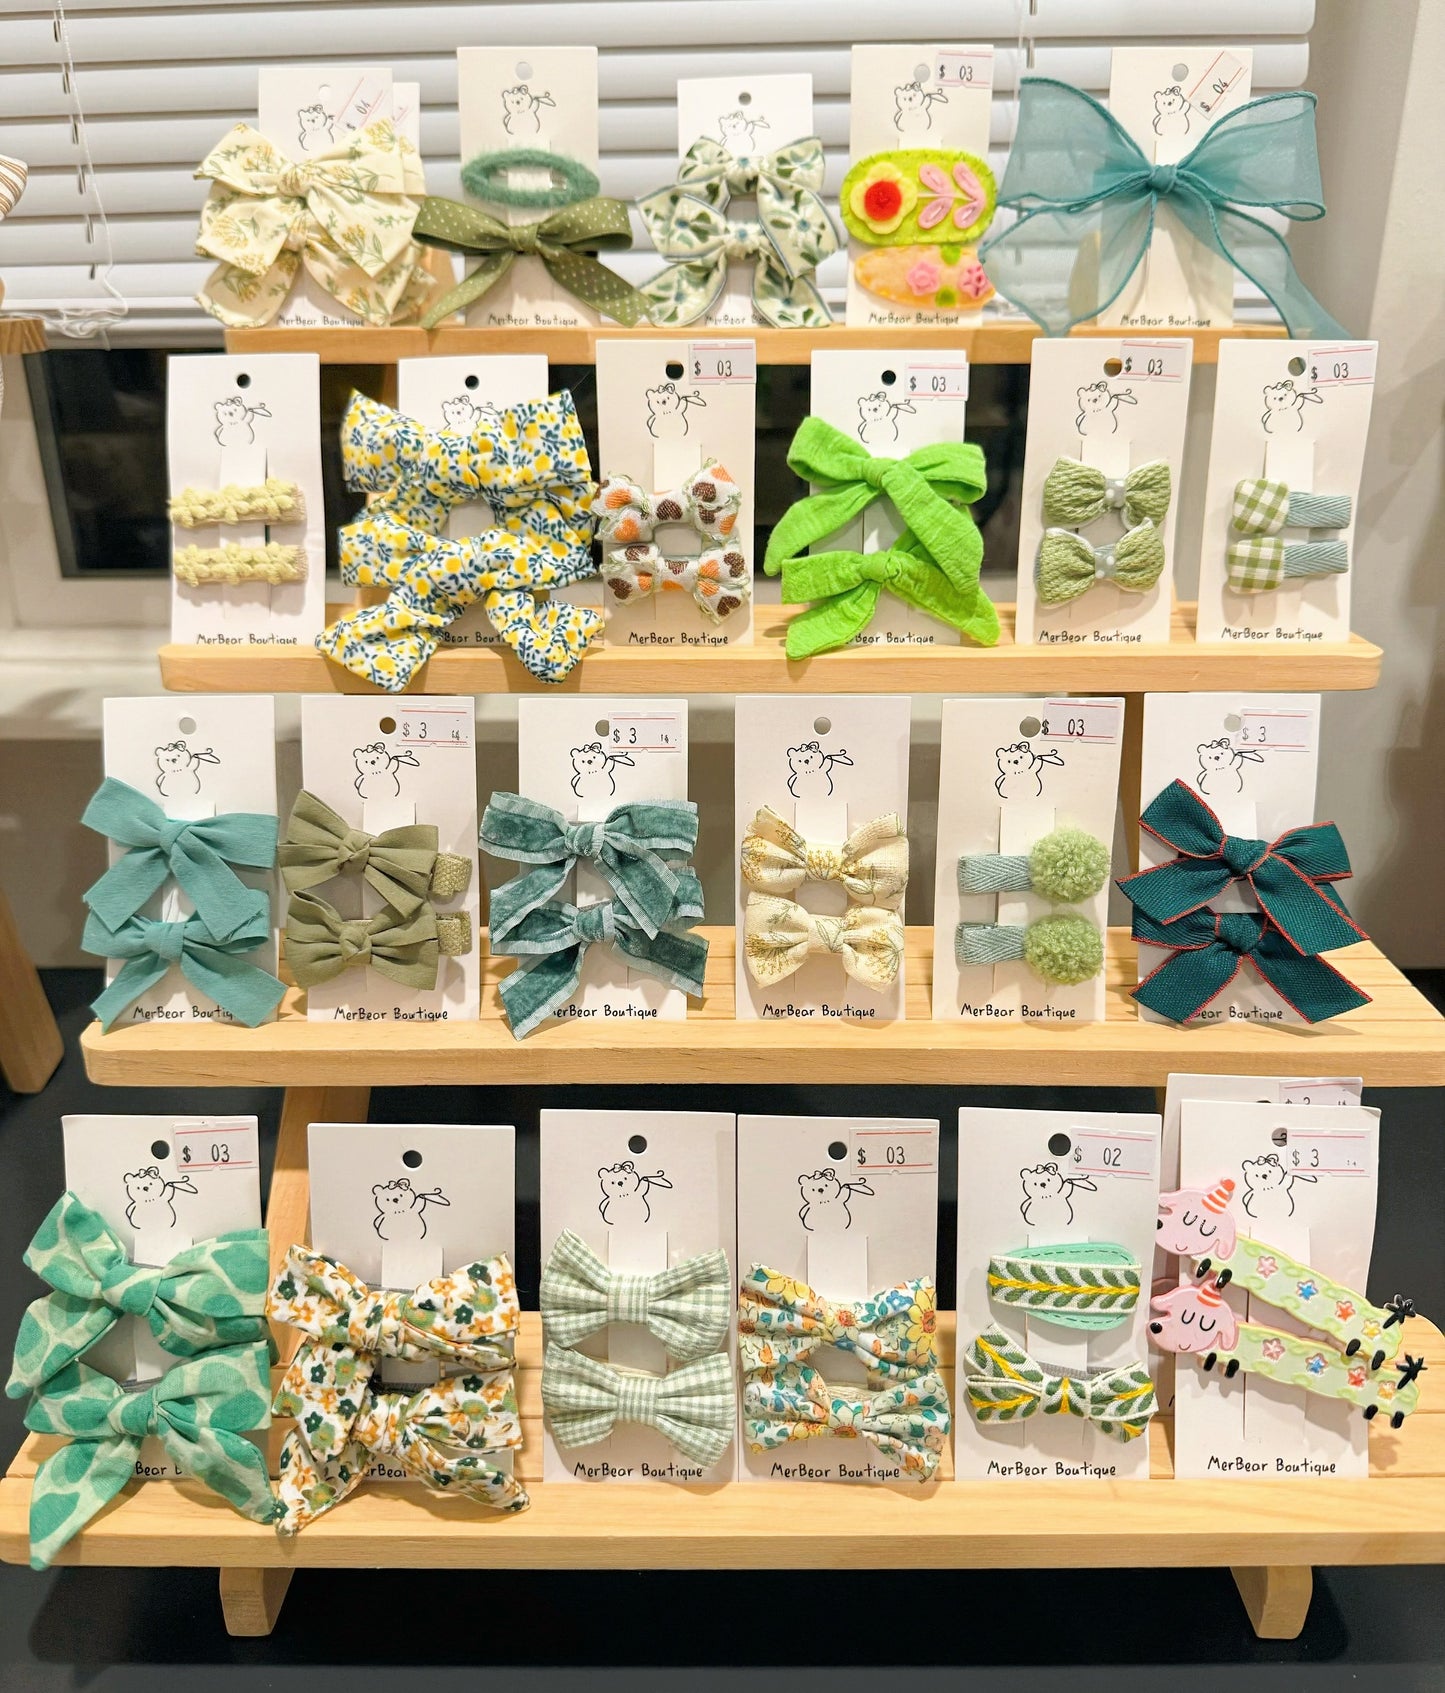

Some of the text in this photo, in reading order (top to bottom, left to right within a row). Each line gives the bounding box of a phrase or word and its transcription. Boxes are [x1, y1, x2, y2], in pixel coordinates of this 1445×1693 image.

[940, 65, 973, 81] $ 03
[1213, 78, 1228, 94] 04
[279, 314, 365, 328] MerBear Boutique
[488, 313, 577, 327] MerBear Boutique
[868, 312, 959, 326] MerBear Boutique
[1120, 315, 1210, 328] MerBear Boutique
[694, 360, 732, 377] $ 03
[1125, 357, 1163, 376] $ 03
[1310, 362, 1349, 381] $ 03
[910, 376, 946, 392] $ 03
[197, 633, 298, 646] MerBear Boutique
[444, 631, 503, 643] Bear Bout
[628, 632, 728, 646] MerBear Boutique
[856, 632, 934, 646] Bear Boutique
[1038, 630, 1141, 644] MerBear Boutique
[1221, 627, 1323, 641] MerBear Boutique
[403, 722, 427, 739] $ 3
[613, 727, 637, 744] $ 3
[1042, 719, 1084, 736] $ 03
[1242, 726, 1266, 742] $ 3
[133, 1006, 233, 1021] MerBear Boutiq
[334, 1006, 448, 1022] MerBear Boutique
[554, 1004, 658, 1020] erBear Boutique
[762, 1003, 875, 1020] MerBear Boutique
[960, 1003, 1075, 1020] MerBear Boutique
[1228, 1005, 1283, 1020] Boutique
[183, 1144, 230, 1163] $ 03
[857, 1146, 905, 1165] $ 03
[1073, 1146, 1122, 1167] $ 02
[1292, 1148, 1319, 1167] $ 3
[135, 1461, 167, 1476] Bear
[574, 1462, 703, 1480] MerBear Boutique
[771, 1462, 900, 1481] MerBear Boutique
[987, 1460, 1116, 1480] MerBear Boutique
[1207, 1456, 1336, 1476] MerBear Boutique
